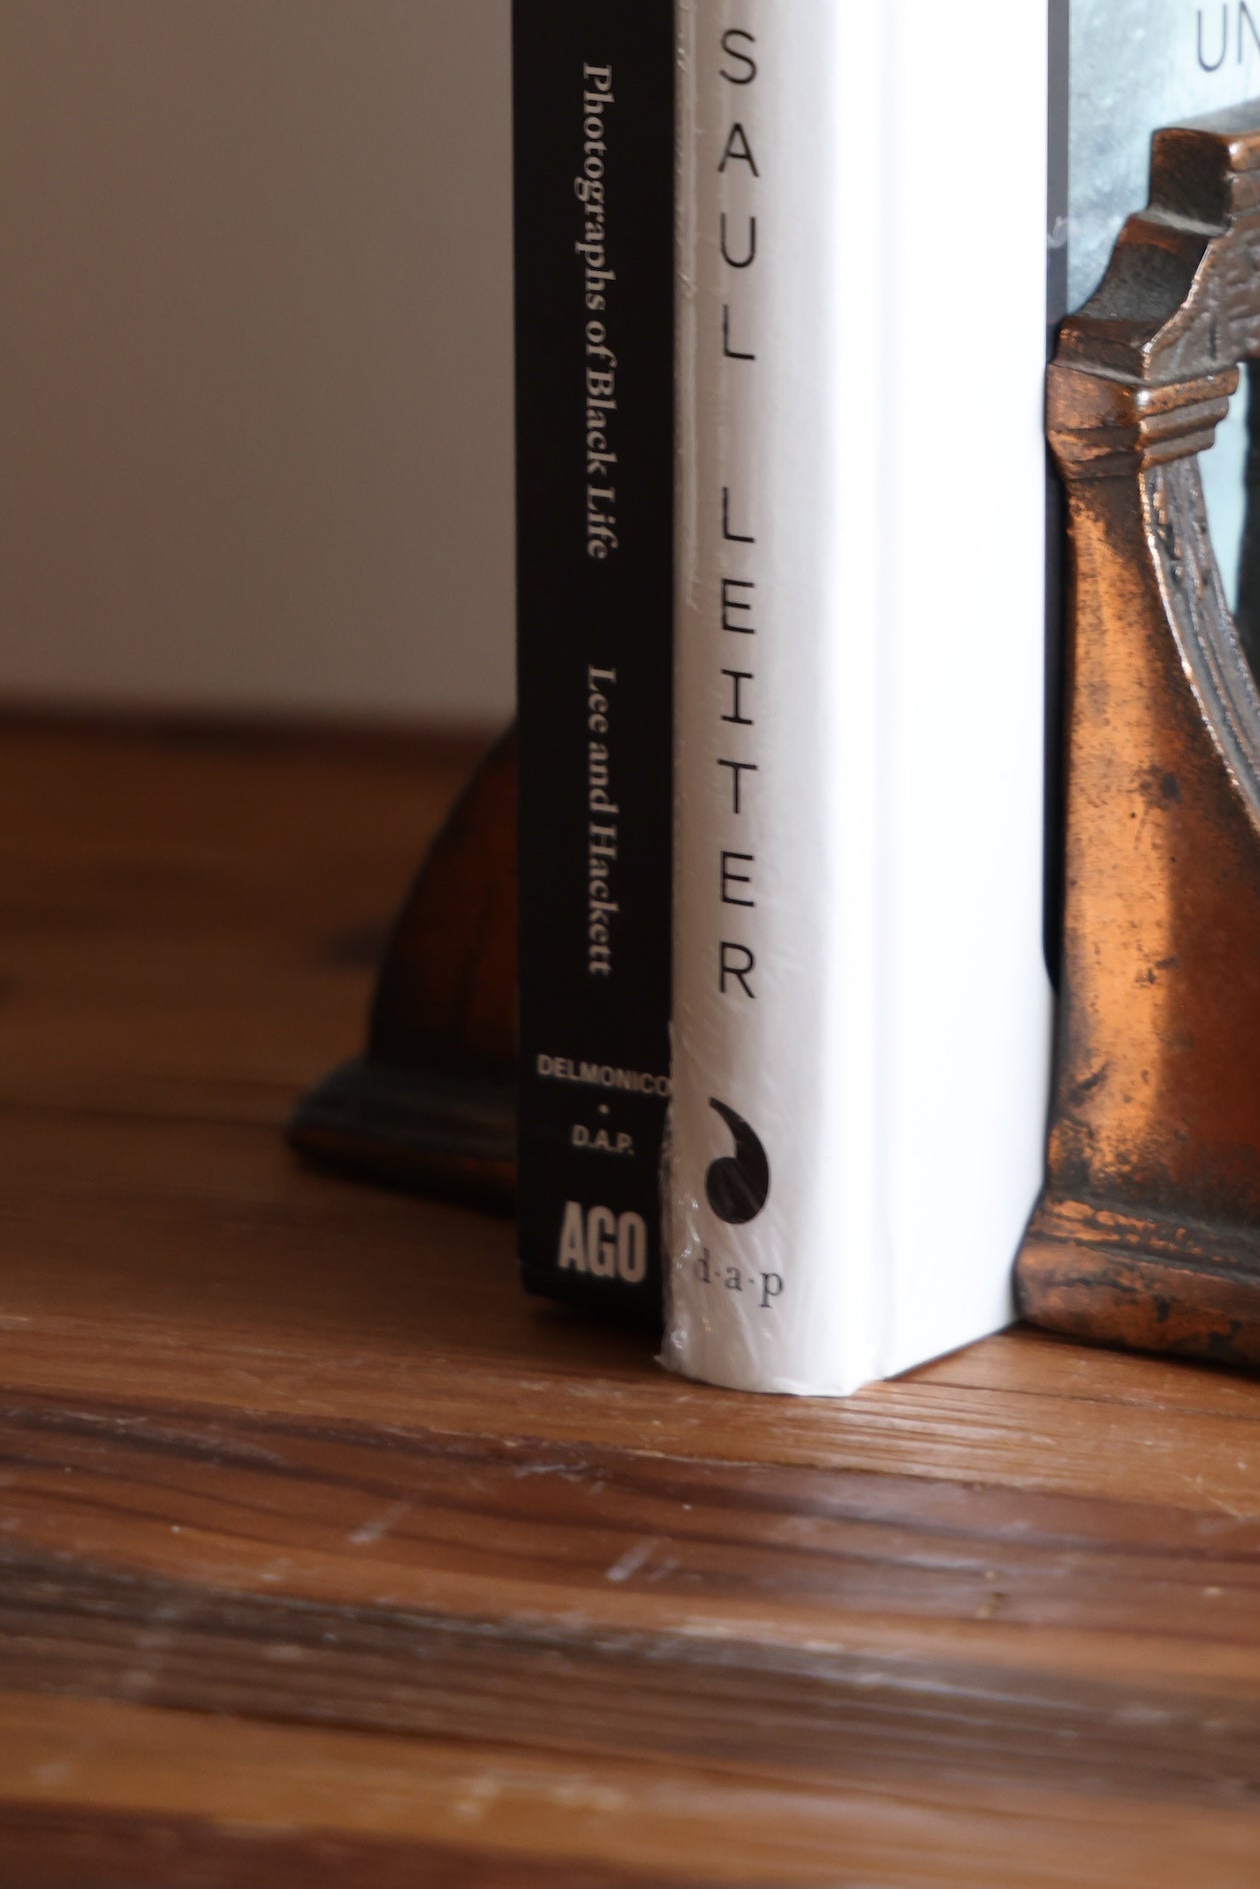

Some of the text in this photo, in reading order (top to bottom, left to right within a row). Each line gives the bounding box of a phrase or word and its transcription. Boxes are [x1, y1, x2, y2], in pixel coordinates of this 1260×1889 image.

[574, 62, 618, 560] Photographs of Black Life
[718, 29, 759, 361] SAUL
[588, 664, 619, 975] Lee and Hackett
[717, 486, 758, 999] LEITER
[537, 1054, 671, 1096] DELMONICO
[557, 1199, 647, 1283] AGO
